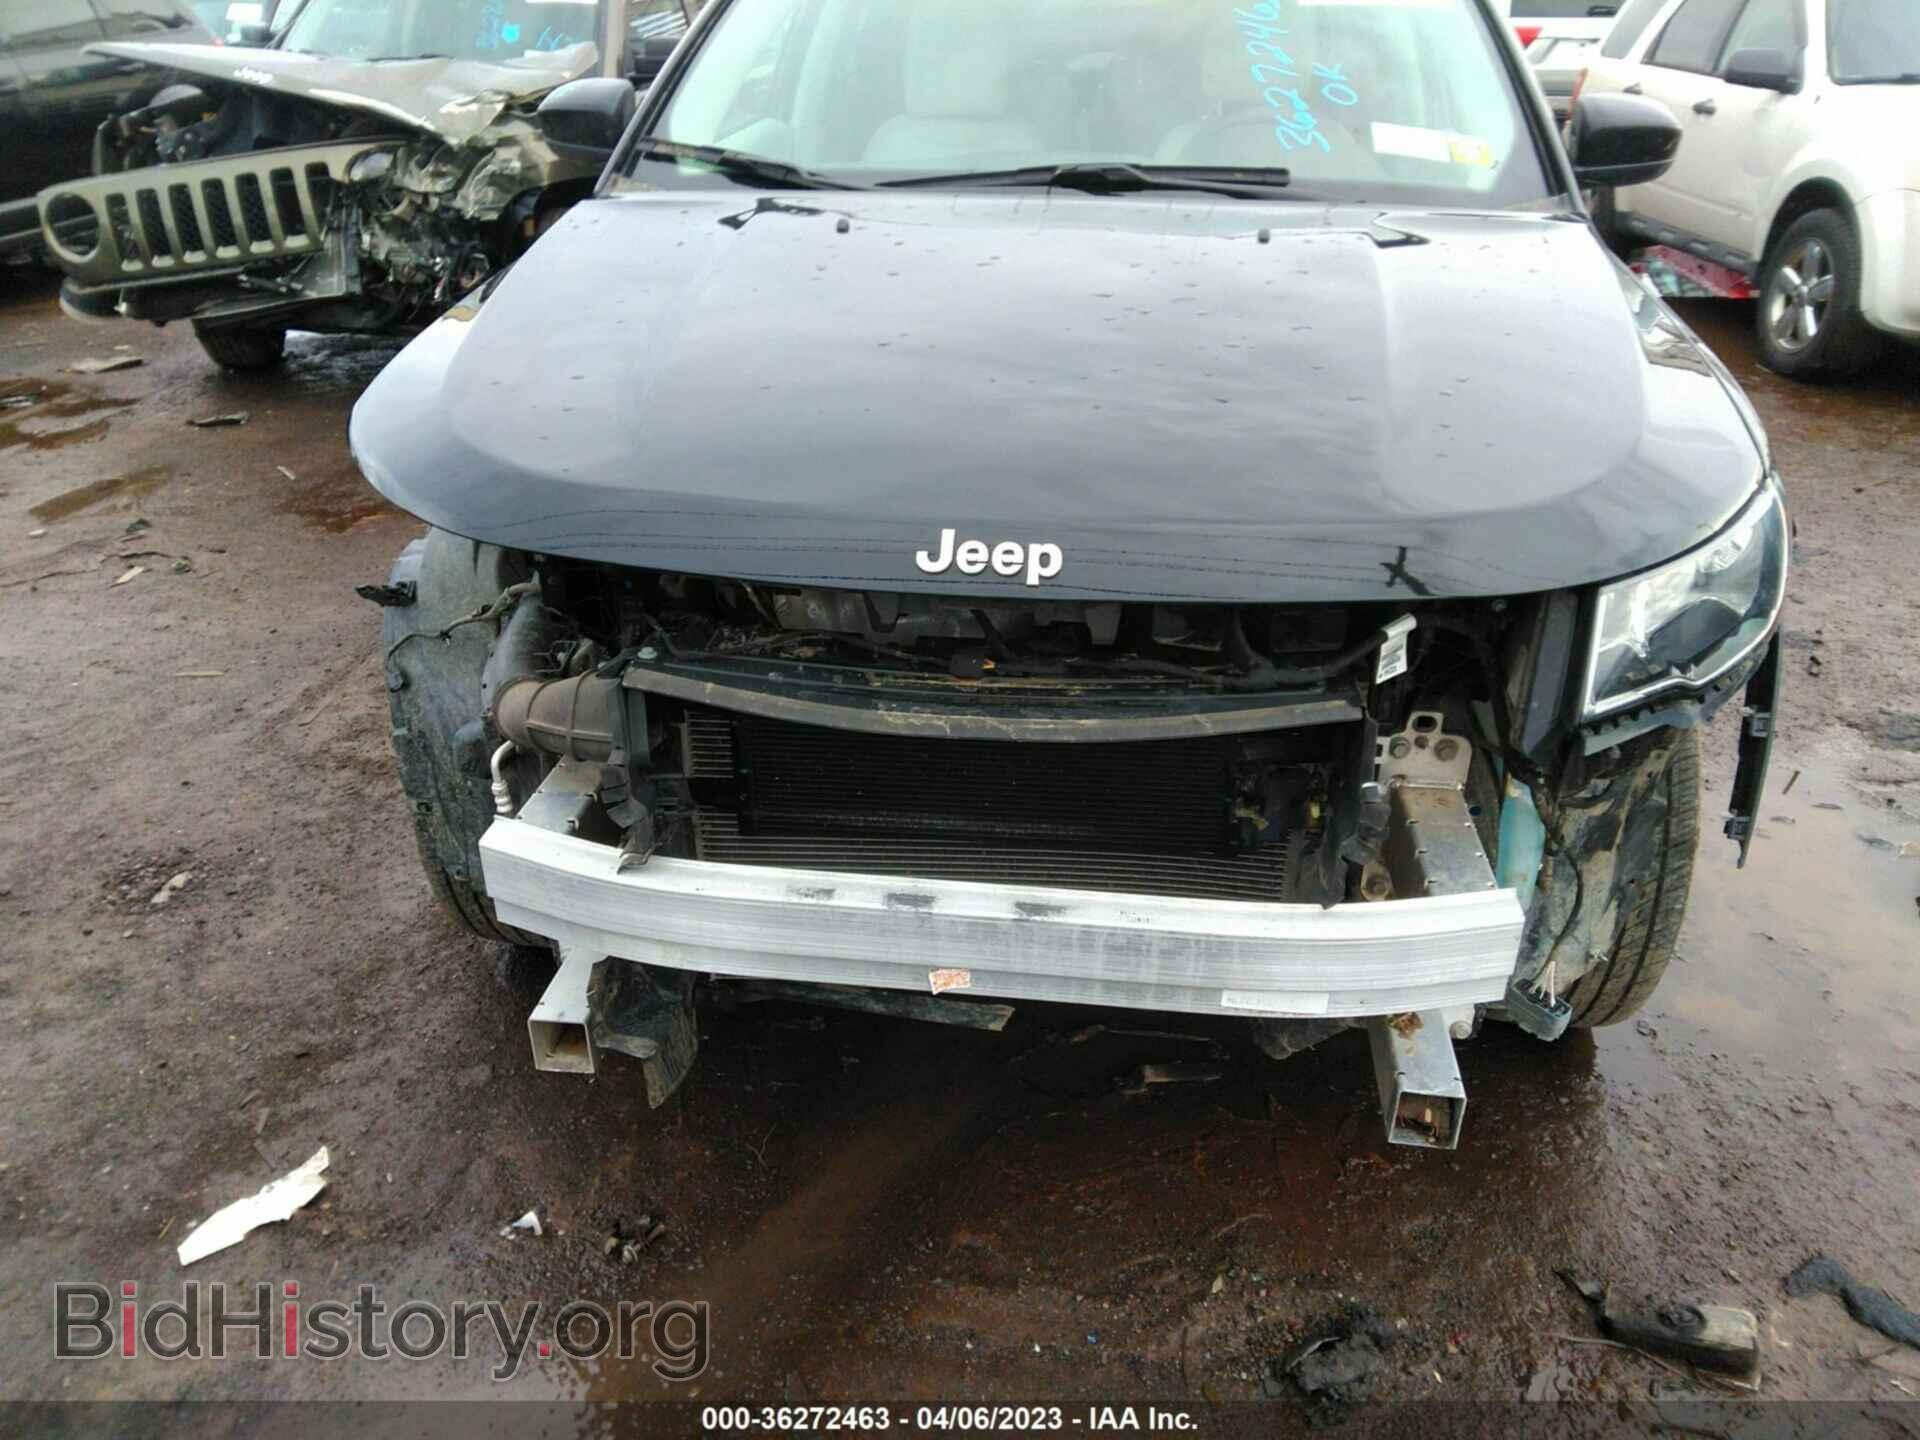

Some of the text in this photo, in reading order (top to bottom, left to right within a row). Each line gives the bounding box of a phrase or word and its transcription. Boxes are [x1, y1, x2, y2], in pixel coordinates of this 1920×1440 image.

[1233, 0, 1330, 152] 3627246
[1311, 62, 1358, 106] OK
[915, 528, 1063, 586] Jeep
